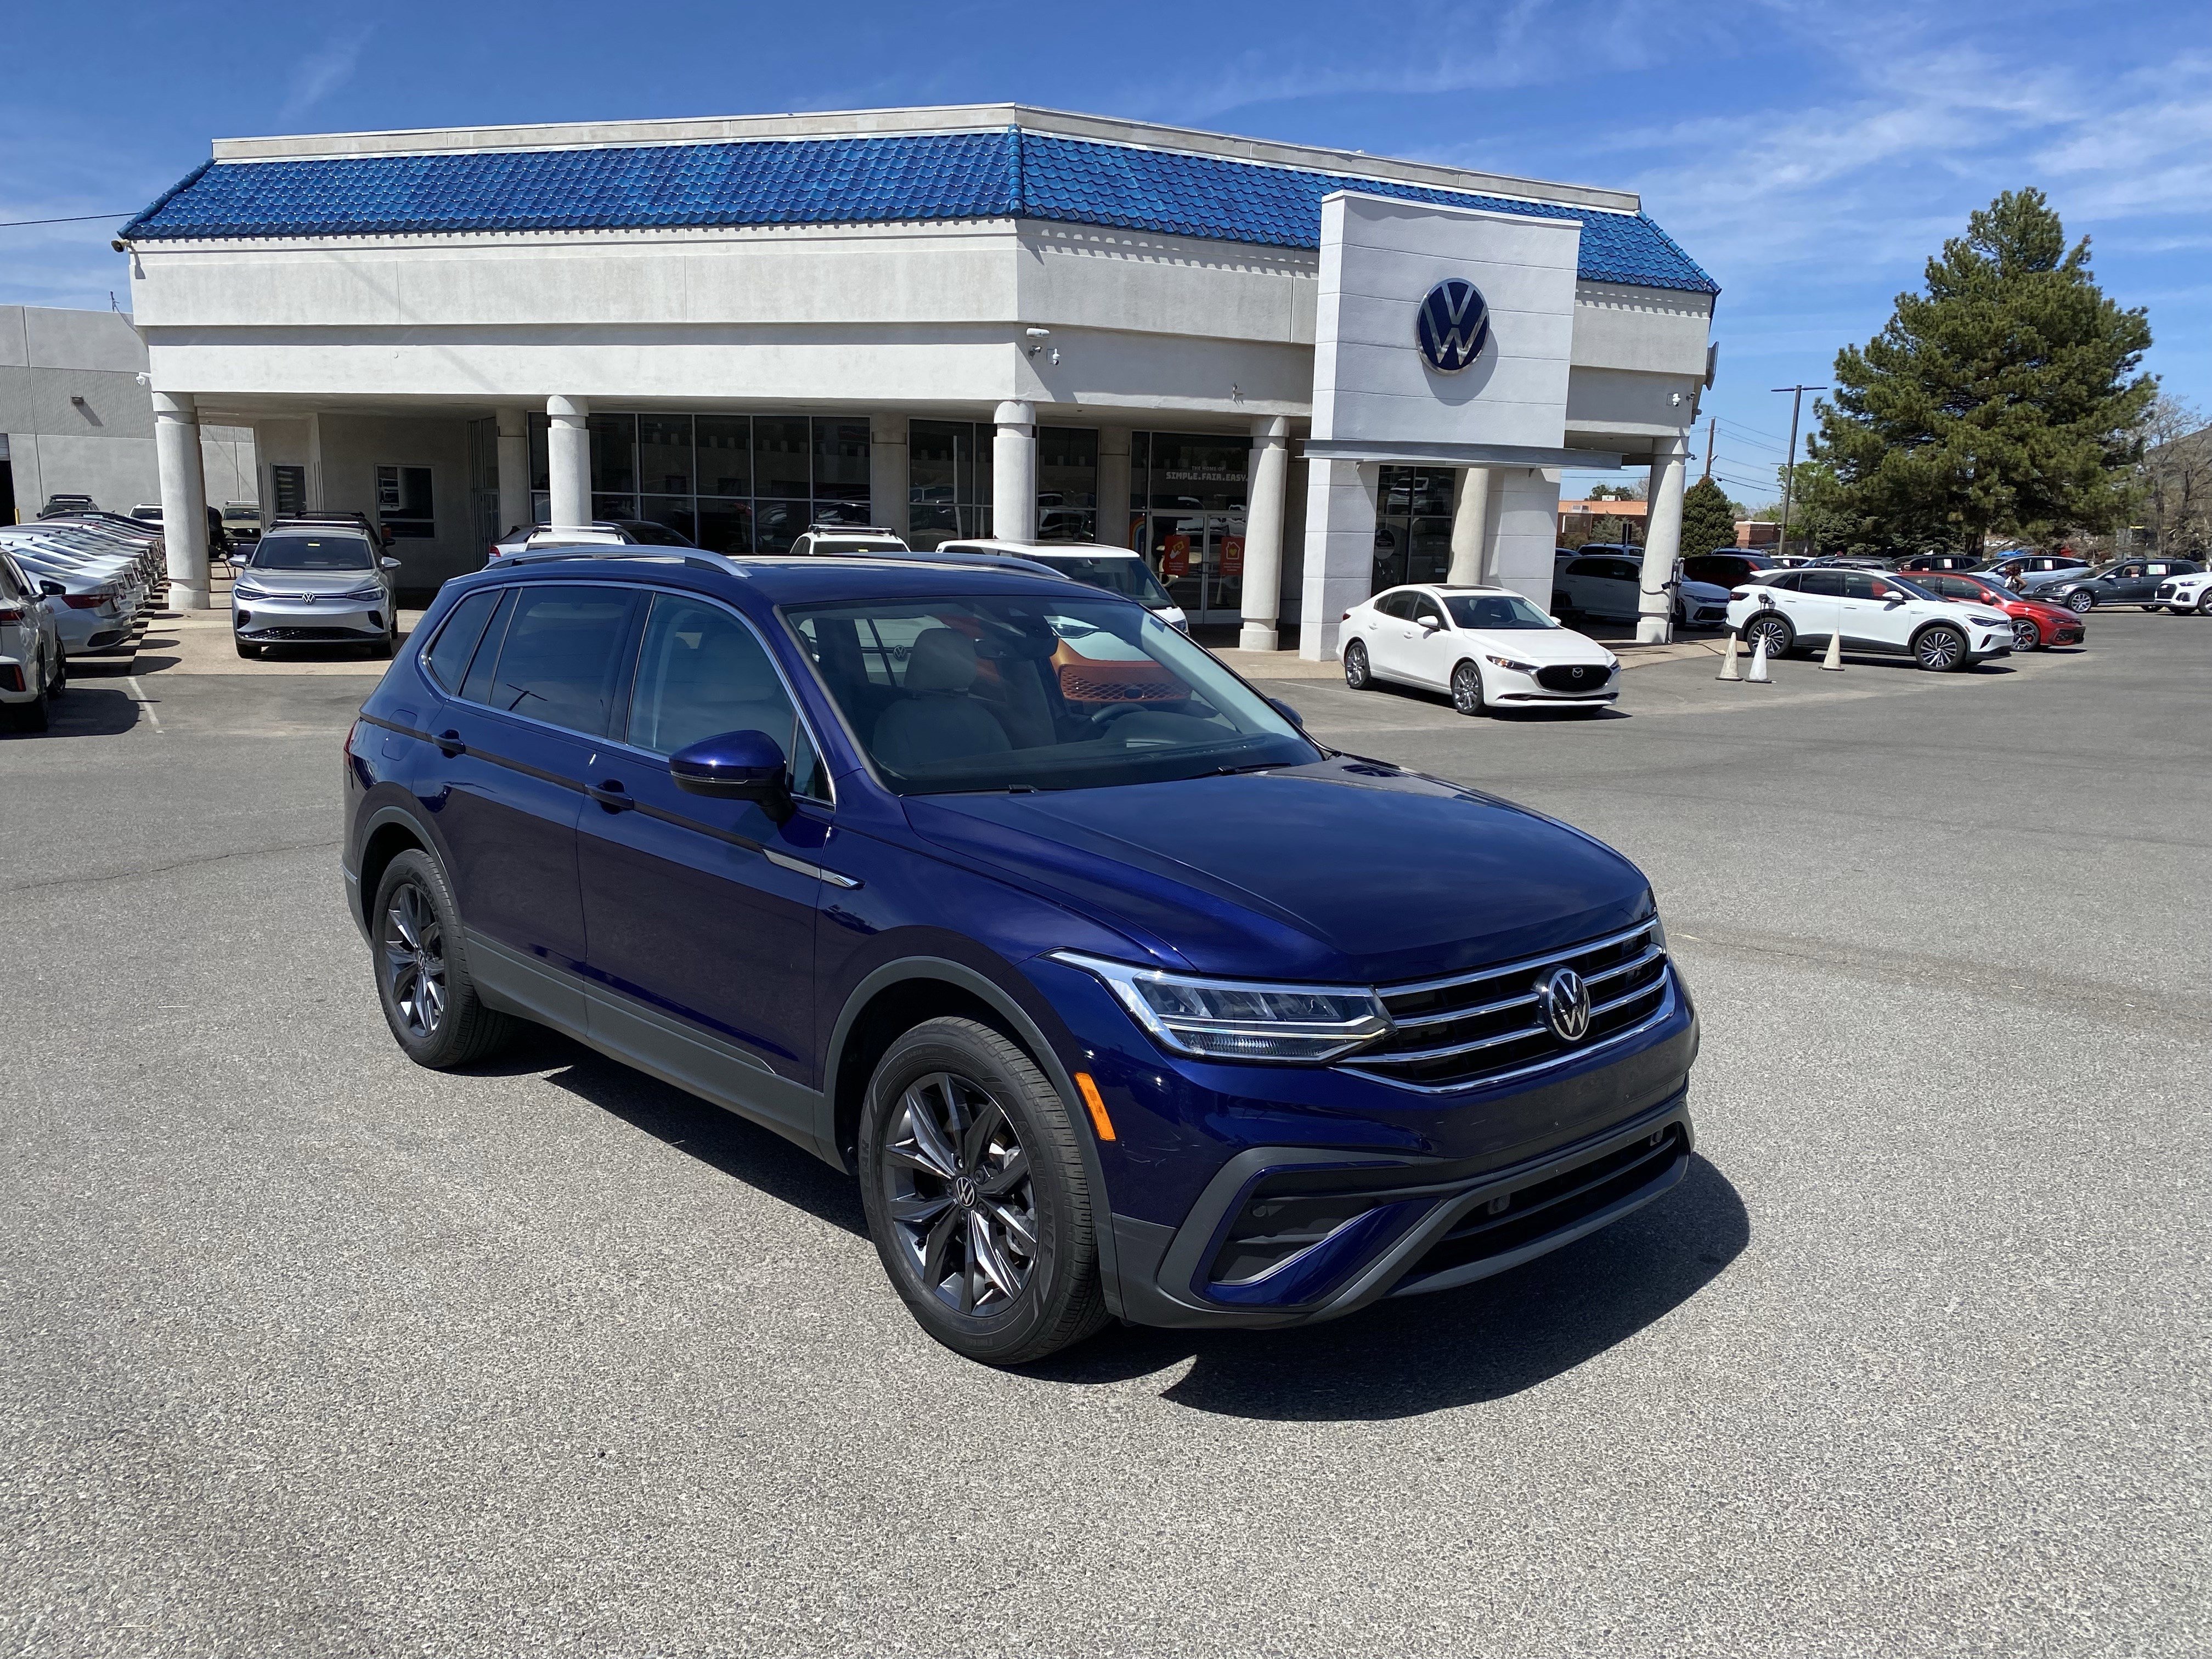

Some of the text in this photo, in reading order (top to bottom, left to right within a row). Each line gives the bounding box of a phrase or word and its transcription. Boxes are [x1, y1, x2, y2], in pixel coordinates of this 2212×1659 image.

[1415, 278, 1490, 375] VW
[1549, 968, 1590, 1041] VW
[956, 1177, 974, 1206] VW
[1017, 1120, 1053, 1259] ASSURANCE
